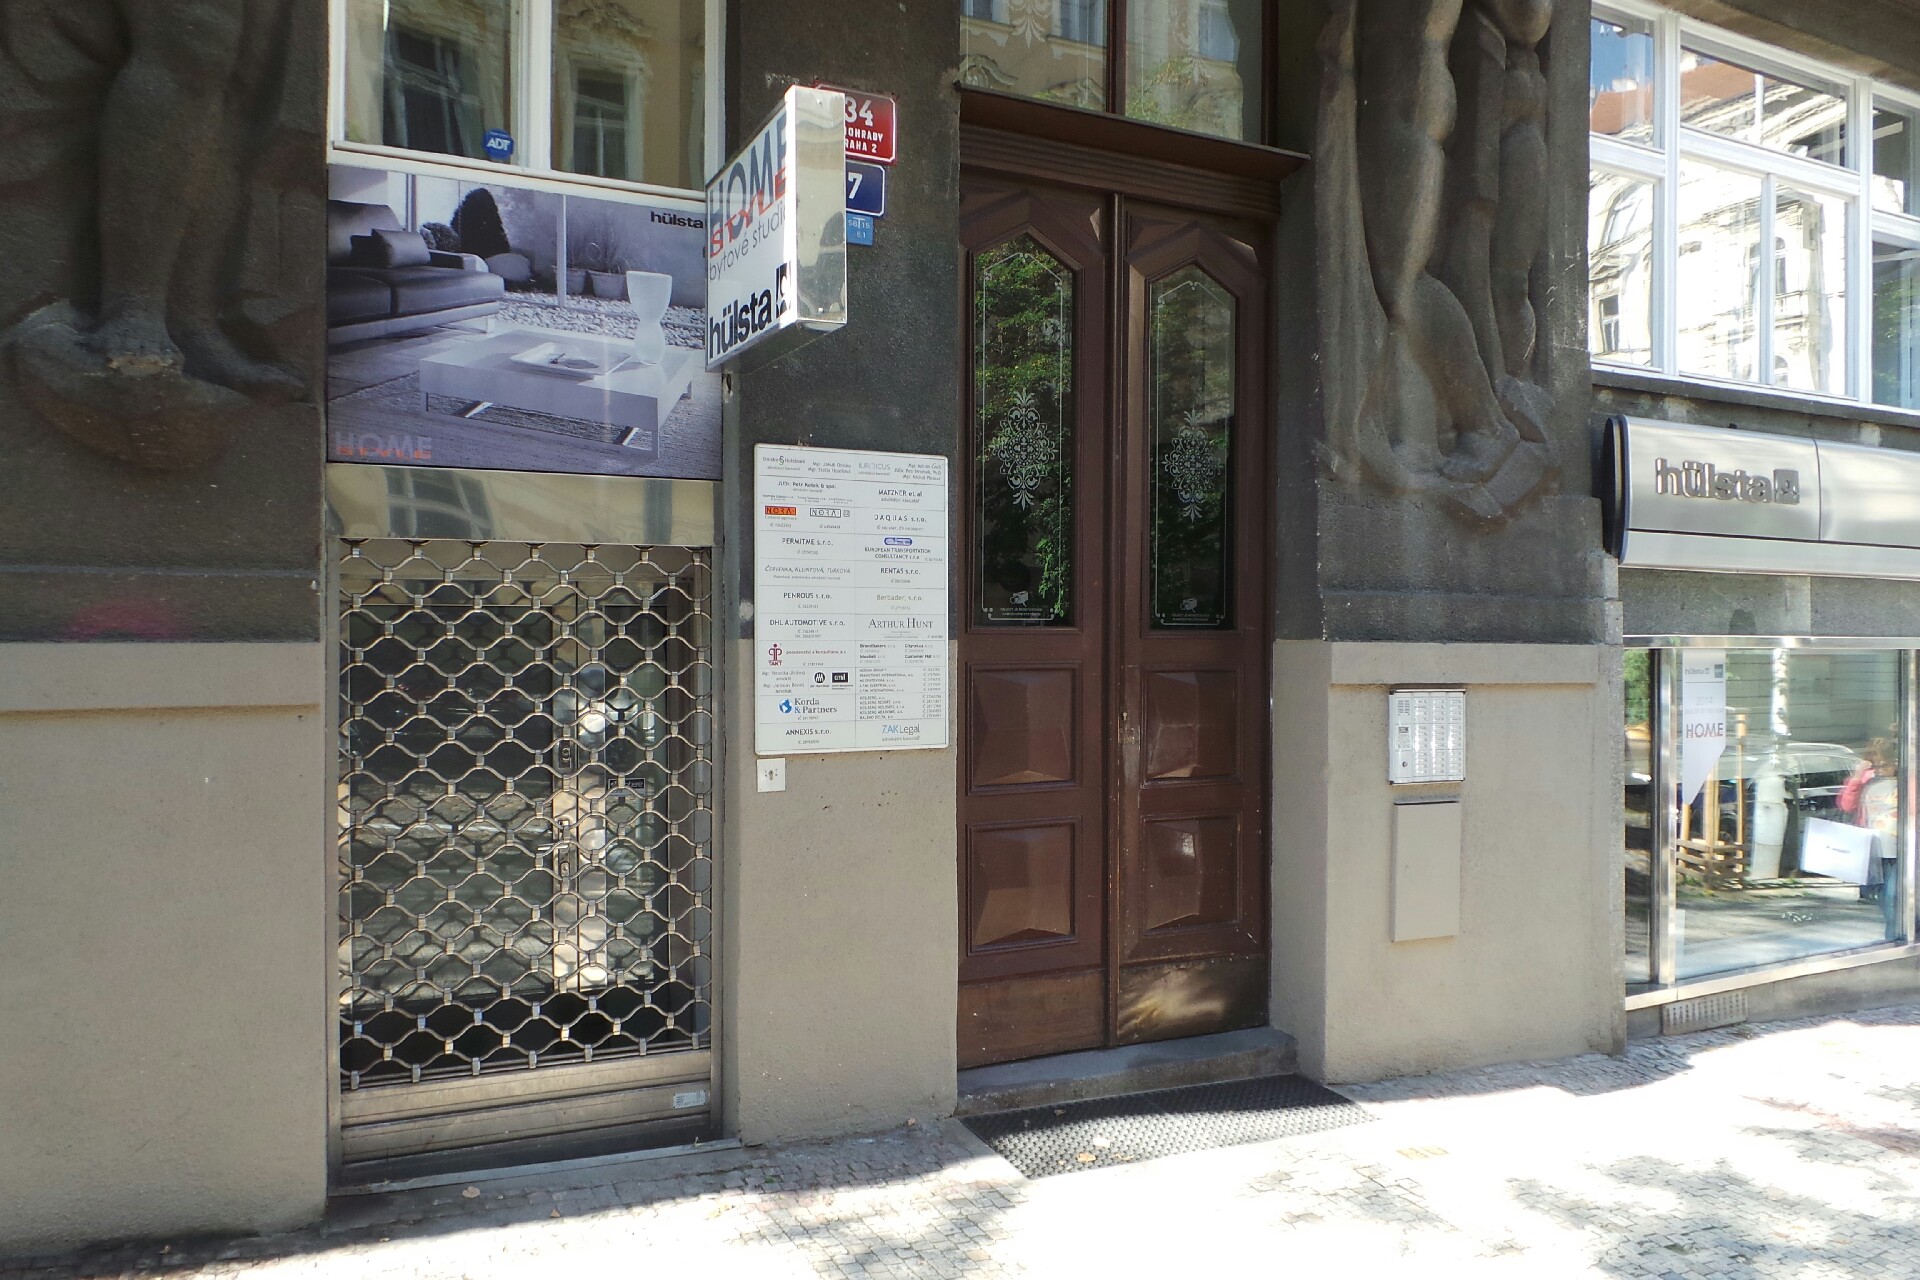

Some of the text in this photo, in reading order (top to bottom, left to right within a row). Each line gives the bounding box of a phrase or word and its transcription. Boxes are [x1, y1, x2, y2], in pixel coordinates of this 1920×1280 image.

[486, 137, 510, 151] ADT
[872, 144, 878, 154] 2
[848, 172, 863, 200] 7
[650, 210, 704, 228] hülsta
[708, 167, 787, 259] STYLE
[709, 231, 750, 281] bytové
[709, 284, 774, 360] hülsta
[336, 432, 432, 461] HOME
[1654, 457, 1772, 504] hülsta
[868, 618, 933, 629] ARTHUR HUNT
[1686, 723, 1723, 738] HOME
